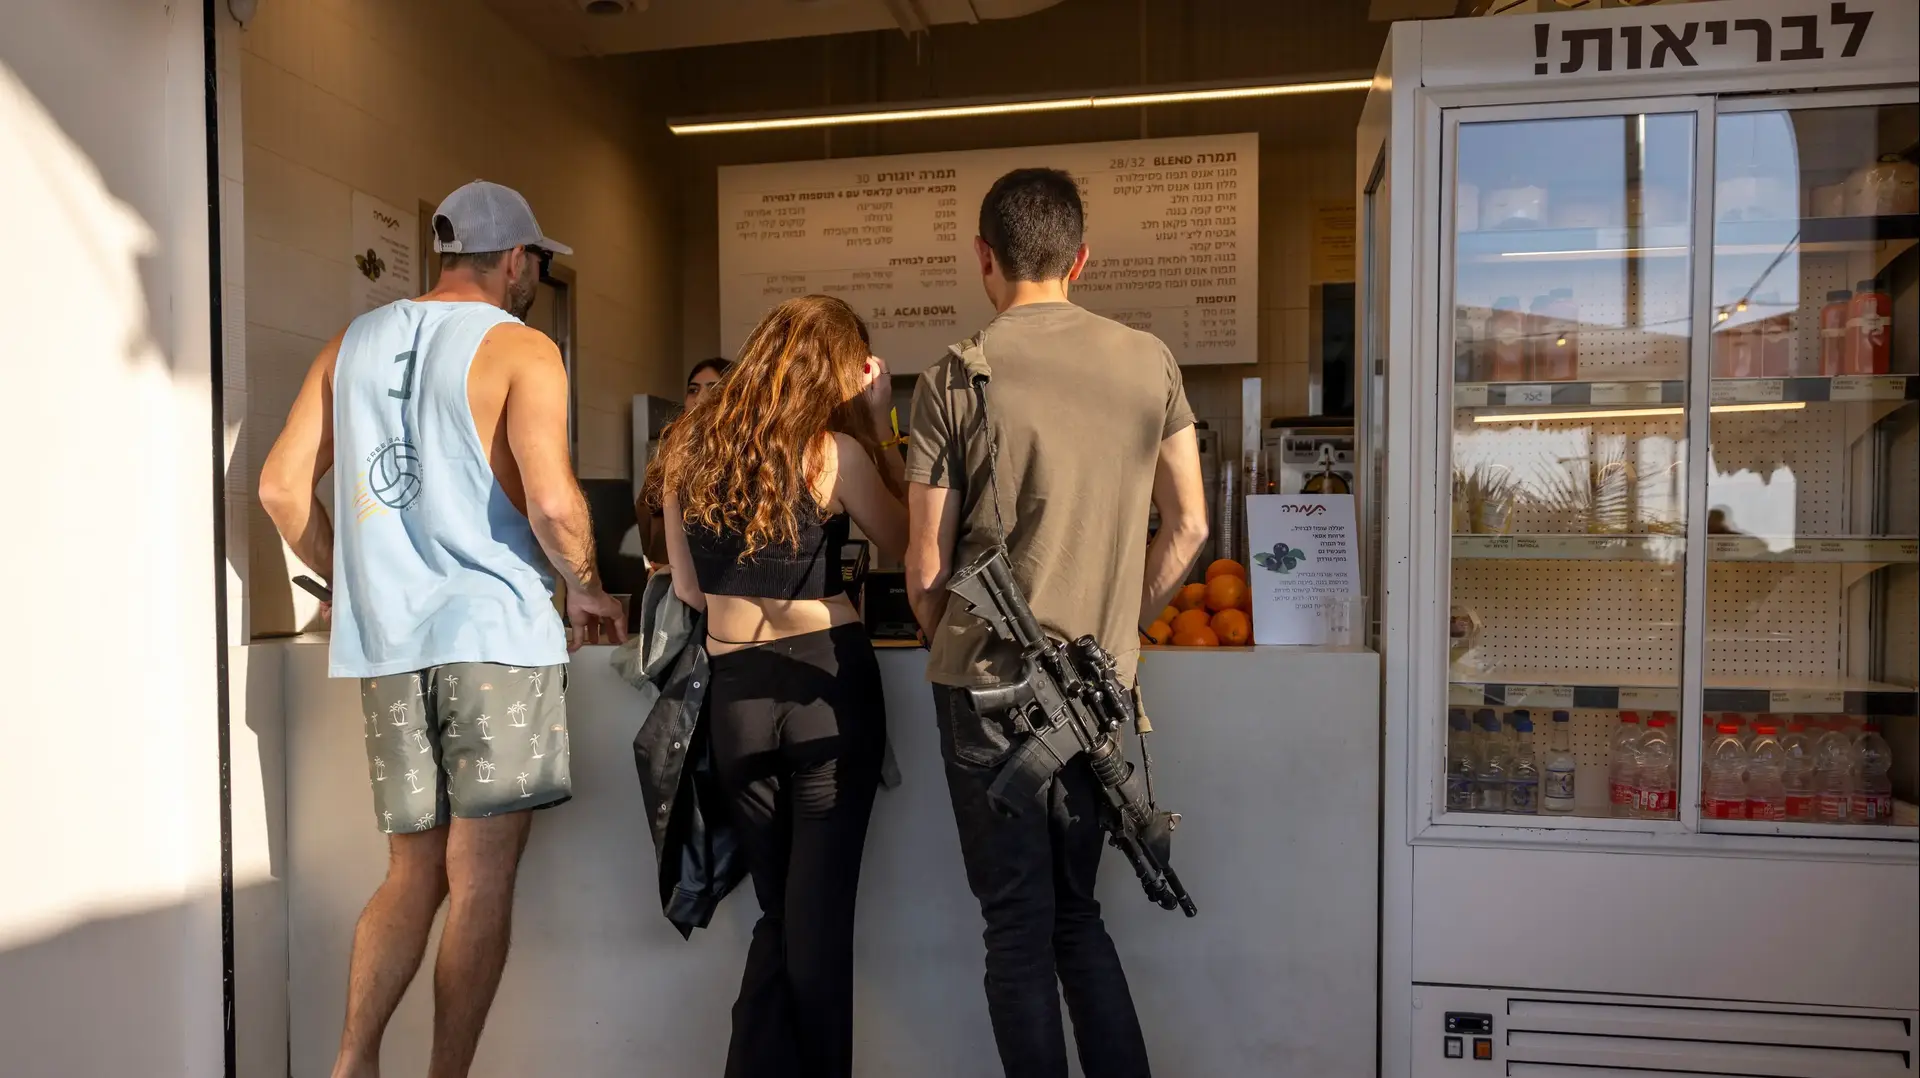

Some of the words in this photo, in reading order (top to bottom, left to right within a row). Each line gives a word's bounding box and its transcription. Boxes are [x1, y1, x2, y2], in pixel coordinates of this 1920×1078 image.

[1533, 2, 1875, 76] לבריאות!
[1153, 155, 1193, 166] BLEND
[1196, 152, 1237, 164] תמרה
[1109, 157, 1145, 169] 28/32
[877, 171, 914, 182] יוגורט
[919, 168, 957, 180] תמרה
[1115, 172, 1163, 182] פסיפלורה
[1191, 170, 1215, 179] אננס
[1217, 168, 1238, 177] מנגו
[855, 173, 870, 183] 30
[1146, 184, 1165, 193] חלב
[1167, 183, 1190, 192] אננס
[1216, 179, 1237, 189] מלון
[845, 190, 860, 199] עם
[862, 188, 893, 197] קלאסי
[896, 187, 926, 196] יוגורט
[1113, 185, 1143, 195] קוקוס
[762, 193, 796, 202] לבחירה
[798, 192, 835, 201] תוספות
[1170, 195, 1189, 204] חלב
[1191, 194, 1214, 203] בננה
[1217, 192, 1237, 201] תות
[1165, 208, 1188, 217] בננה
[1190, 207, 1212, 216] קפה
[1215, 205, 1237, 214] אייס
[934, 210, 957, 219] אננס
[1140, 220, 1160, 229] חלב
[1162, 219, 1188, 229] פקאן
[1191, 217, 1212, 226] תמר
[1215, 216, 1237, 225] בננה
[933, 221, 957, 231] פקאן
[936, 232, 957, 241] בננה
[1155, 231, 1178, 241] נענע
[1205, 228, 1237, 238] אבטיח
[846, 237, 872, 246] פירות
[1213, 240, 1236, 249] אייס
[1189, 242, 1211, 251] קפה
[888, 256, 924, 266] לבחירה
[926, 255, 957, 264] רטבים
[1122, 257, 1154, 266] בוטנים
[1157, 256, 1187, 265] חמאת
[1190, 255, 1212, 264] תמר
[1214, 253, 1236, 262] בננה
[1101, 258, 1120, 267] חלב
[1083, 270, 1107, 281] לימון
[1110, 269, 1156, 279] פסיפלורה
[1184, 267, 1207, 276] אננס
[1115, 281, 1162, 291] פסיפלורה
[1190, 278, 1213, 287] אננס
[1216, 277, 1236, 286] תות
[1071, 283, 1113, 293] אשכולית
[1195, 294, 1237, 304] תוספות
[872, 307, 886, 317] 34
[894, 306, 921, 316] ACAI
[922, 305, 957, 315] BOWL
[387, 350, 418, 401] 1
[366, 442, 388, 463] FREE
